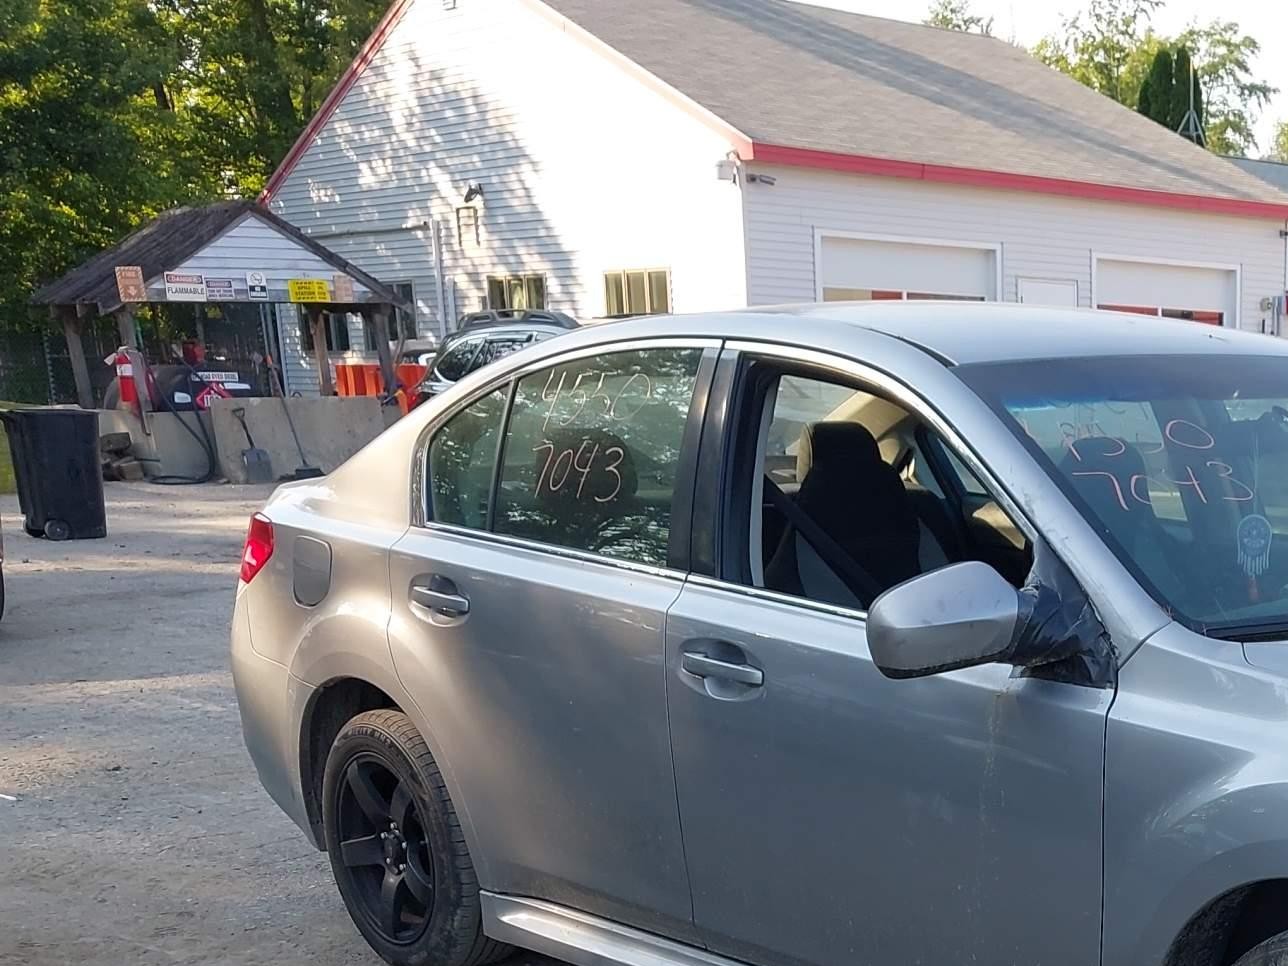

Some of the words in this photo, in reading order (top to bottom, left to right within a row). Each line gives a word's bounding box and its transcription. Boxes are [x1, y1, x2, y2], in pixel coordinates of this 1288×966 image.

[167, 274, 202, 284] DANGER
[167, 286, 205, 295] FLAMMABLE
[542, 369, 651, 432] 4550
[532, 440, 624, 502] 7043
[1071, 459, 1254, 512] 7043
